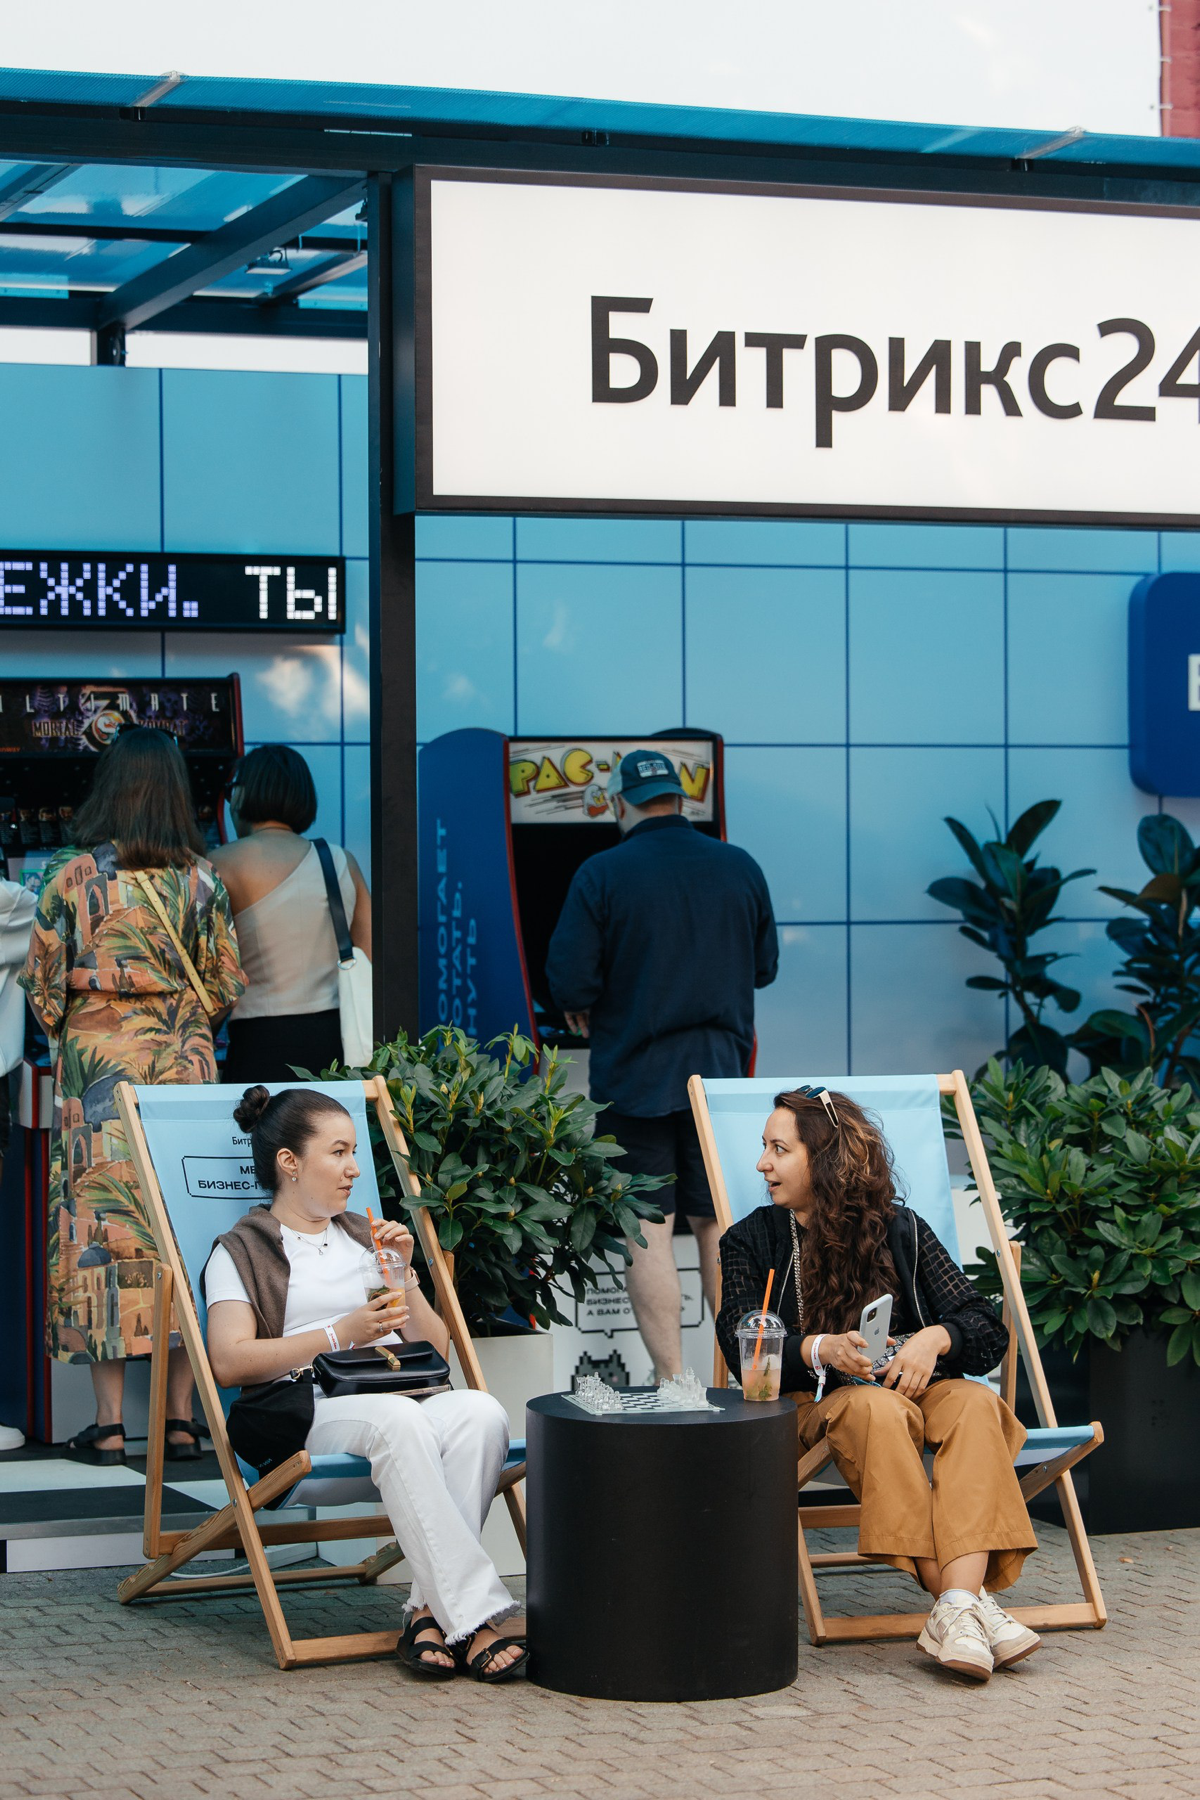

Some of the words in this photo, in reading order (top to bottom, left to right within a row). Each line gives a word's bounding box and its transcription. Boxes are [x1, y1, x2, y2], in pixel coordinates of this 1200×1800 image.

[591, 295, 1200, 449] Битрикс24
[245, 566, 337, 620] ТЫ
[0, 692, 220, 713] LTIMATE
[509, 747, 711, 804] PAC-N
[232, 1136, 252, 1148] Битр
